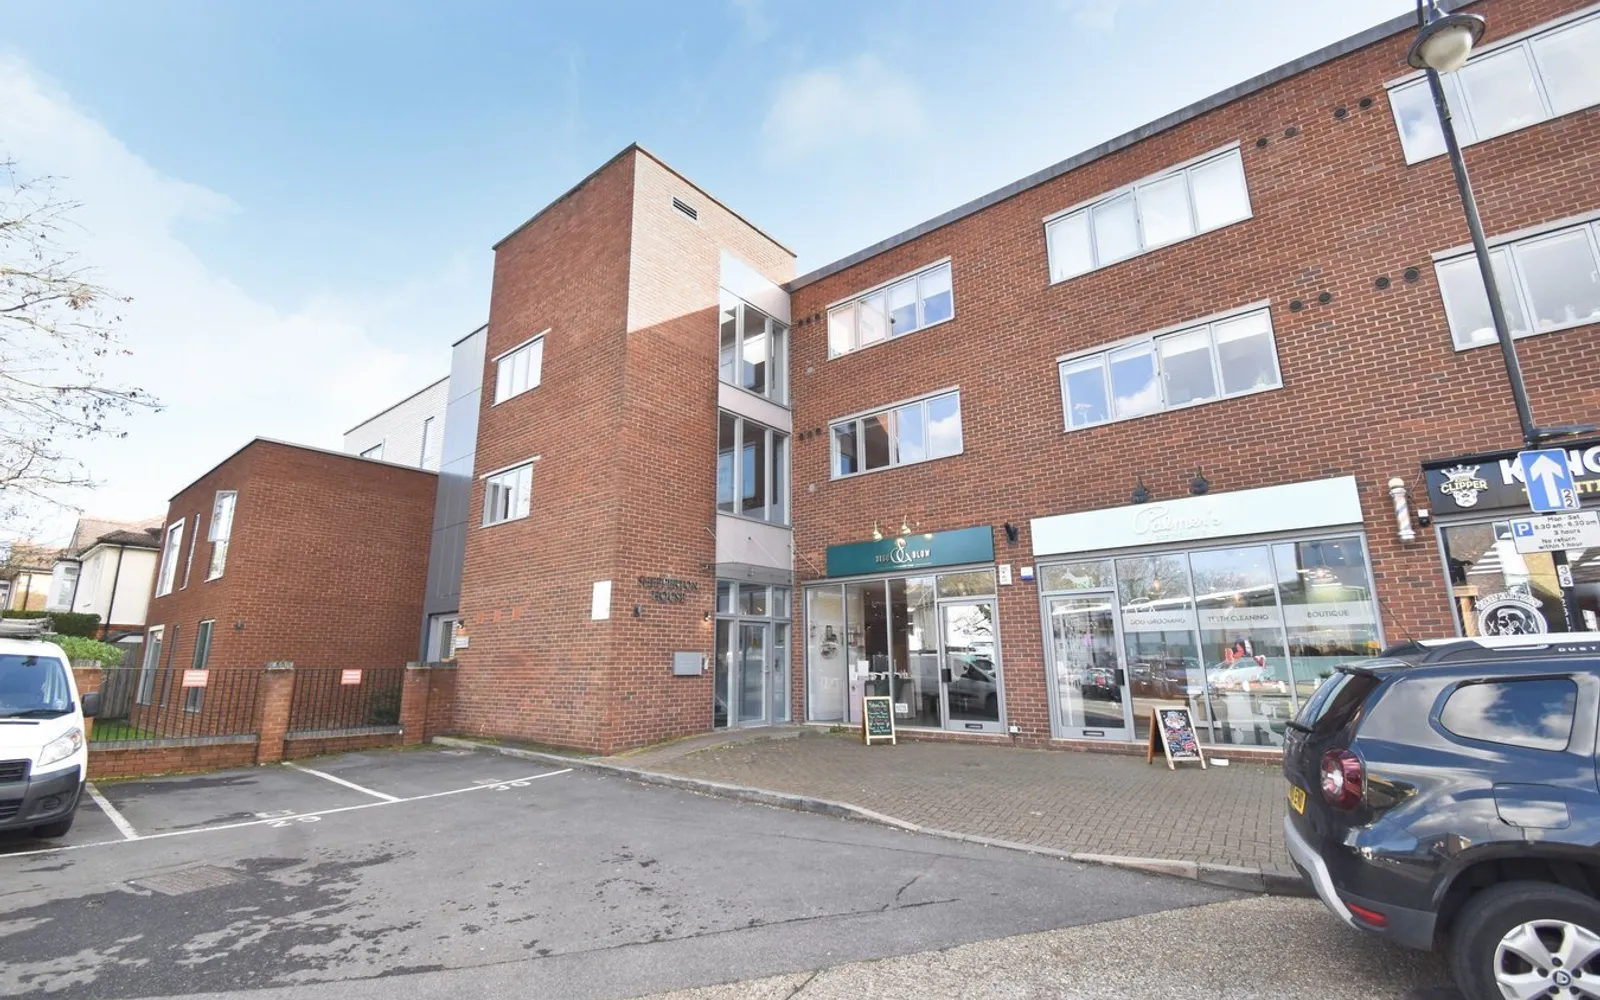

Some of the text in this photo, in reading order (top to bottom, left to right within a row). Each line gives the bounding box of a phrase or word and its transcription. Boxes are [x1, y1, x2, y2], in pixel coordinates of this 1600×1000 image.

[1440, 480, 1488, 494] CLIPPER
[1133, 506, 1224, 535] Palmer's
[1517, 523, 1529, 535] P
[1230, 613, 1269, 622] CLEANING
[1307, 609, 1349, 619] BOUTIQUE
